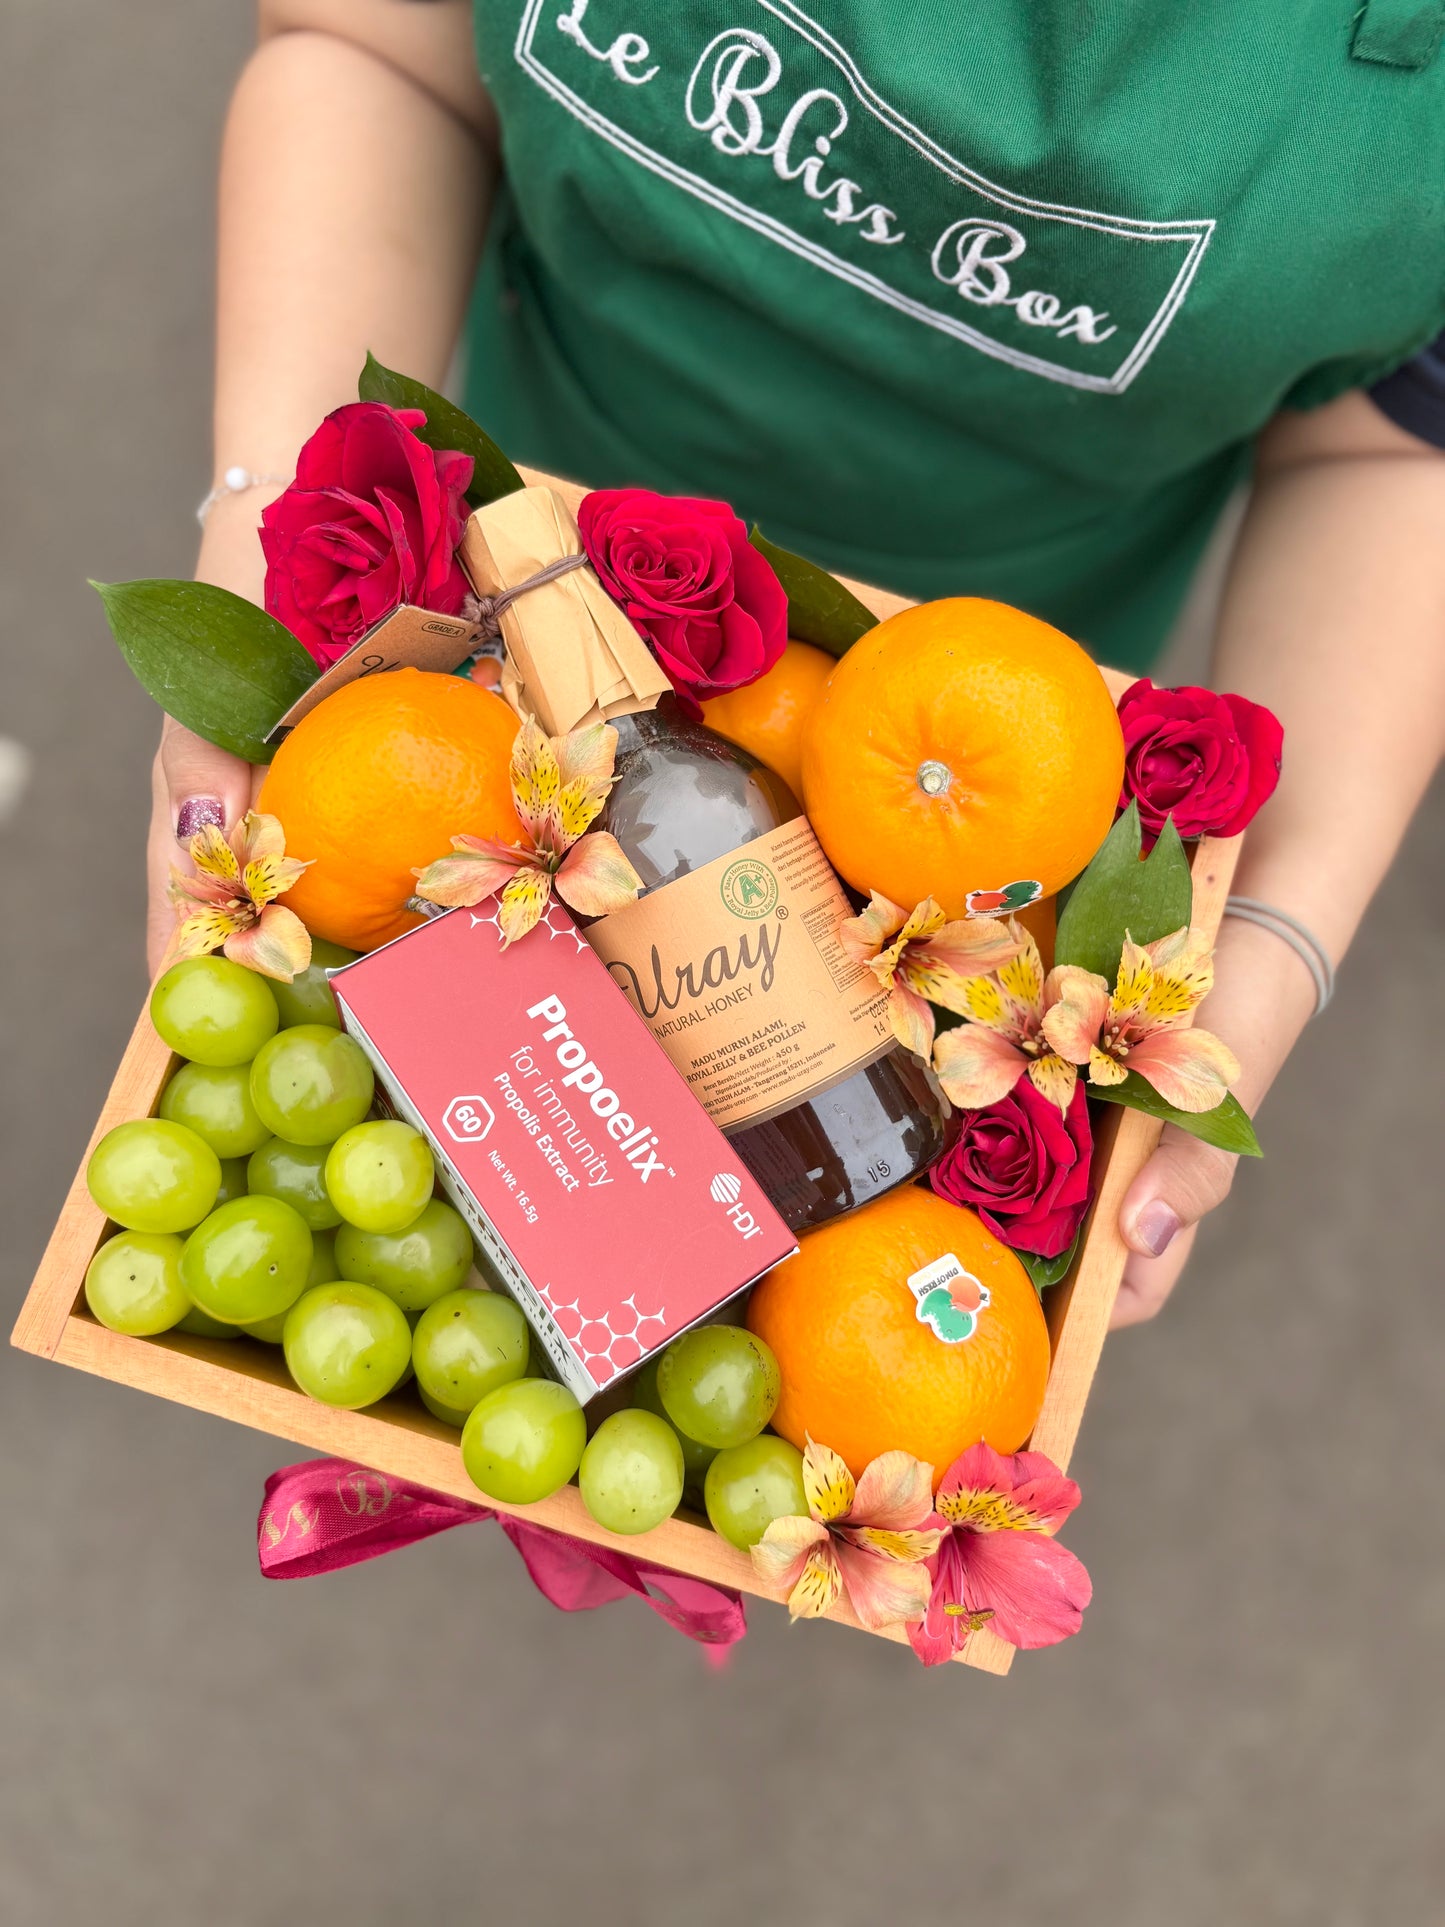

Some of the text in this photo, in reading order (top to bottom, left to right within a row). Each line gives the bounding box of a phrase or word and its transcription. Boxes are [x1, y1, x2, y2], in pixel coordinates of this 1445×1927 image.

[556, 0, 1117, 344] Le Bliss Box
[730, 863, 749, 877] Honey
[654, 983, 753, 1040] NATURAL HONEY
[686, 1021, 807, 1084] ROYAL JELLY & BEE POLLEN
[690, 1019, 788, 1069] MADU MURNI ALAMI,
[755, 1067, 788, 1088] Tangerang
[805, 1041, 837, 1063] Indonesia
[775, 1045, 793, 1059] 450
[792, 1042, 801, 1052] g
[525, 993, 666, 1184] Propoelix
[454, 1104, 482, 1133] 60
[493, 1071, 580, 1193] Propolis Extract
[509, 1045, 615, 1188] for immunity
[487, 1149, 540, 1224] Net Wt. 16.5g
[866, 1159, 892, 1184] 15
[725, 1201, 761, 1240] HDI
